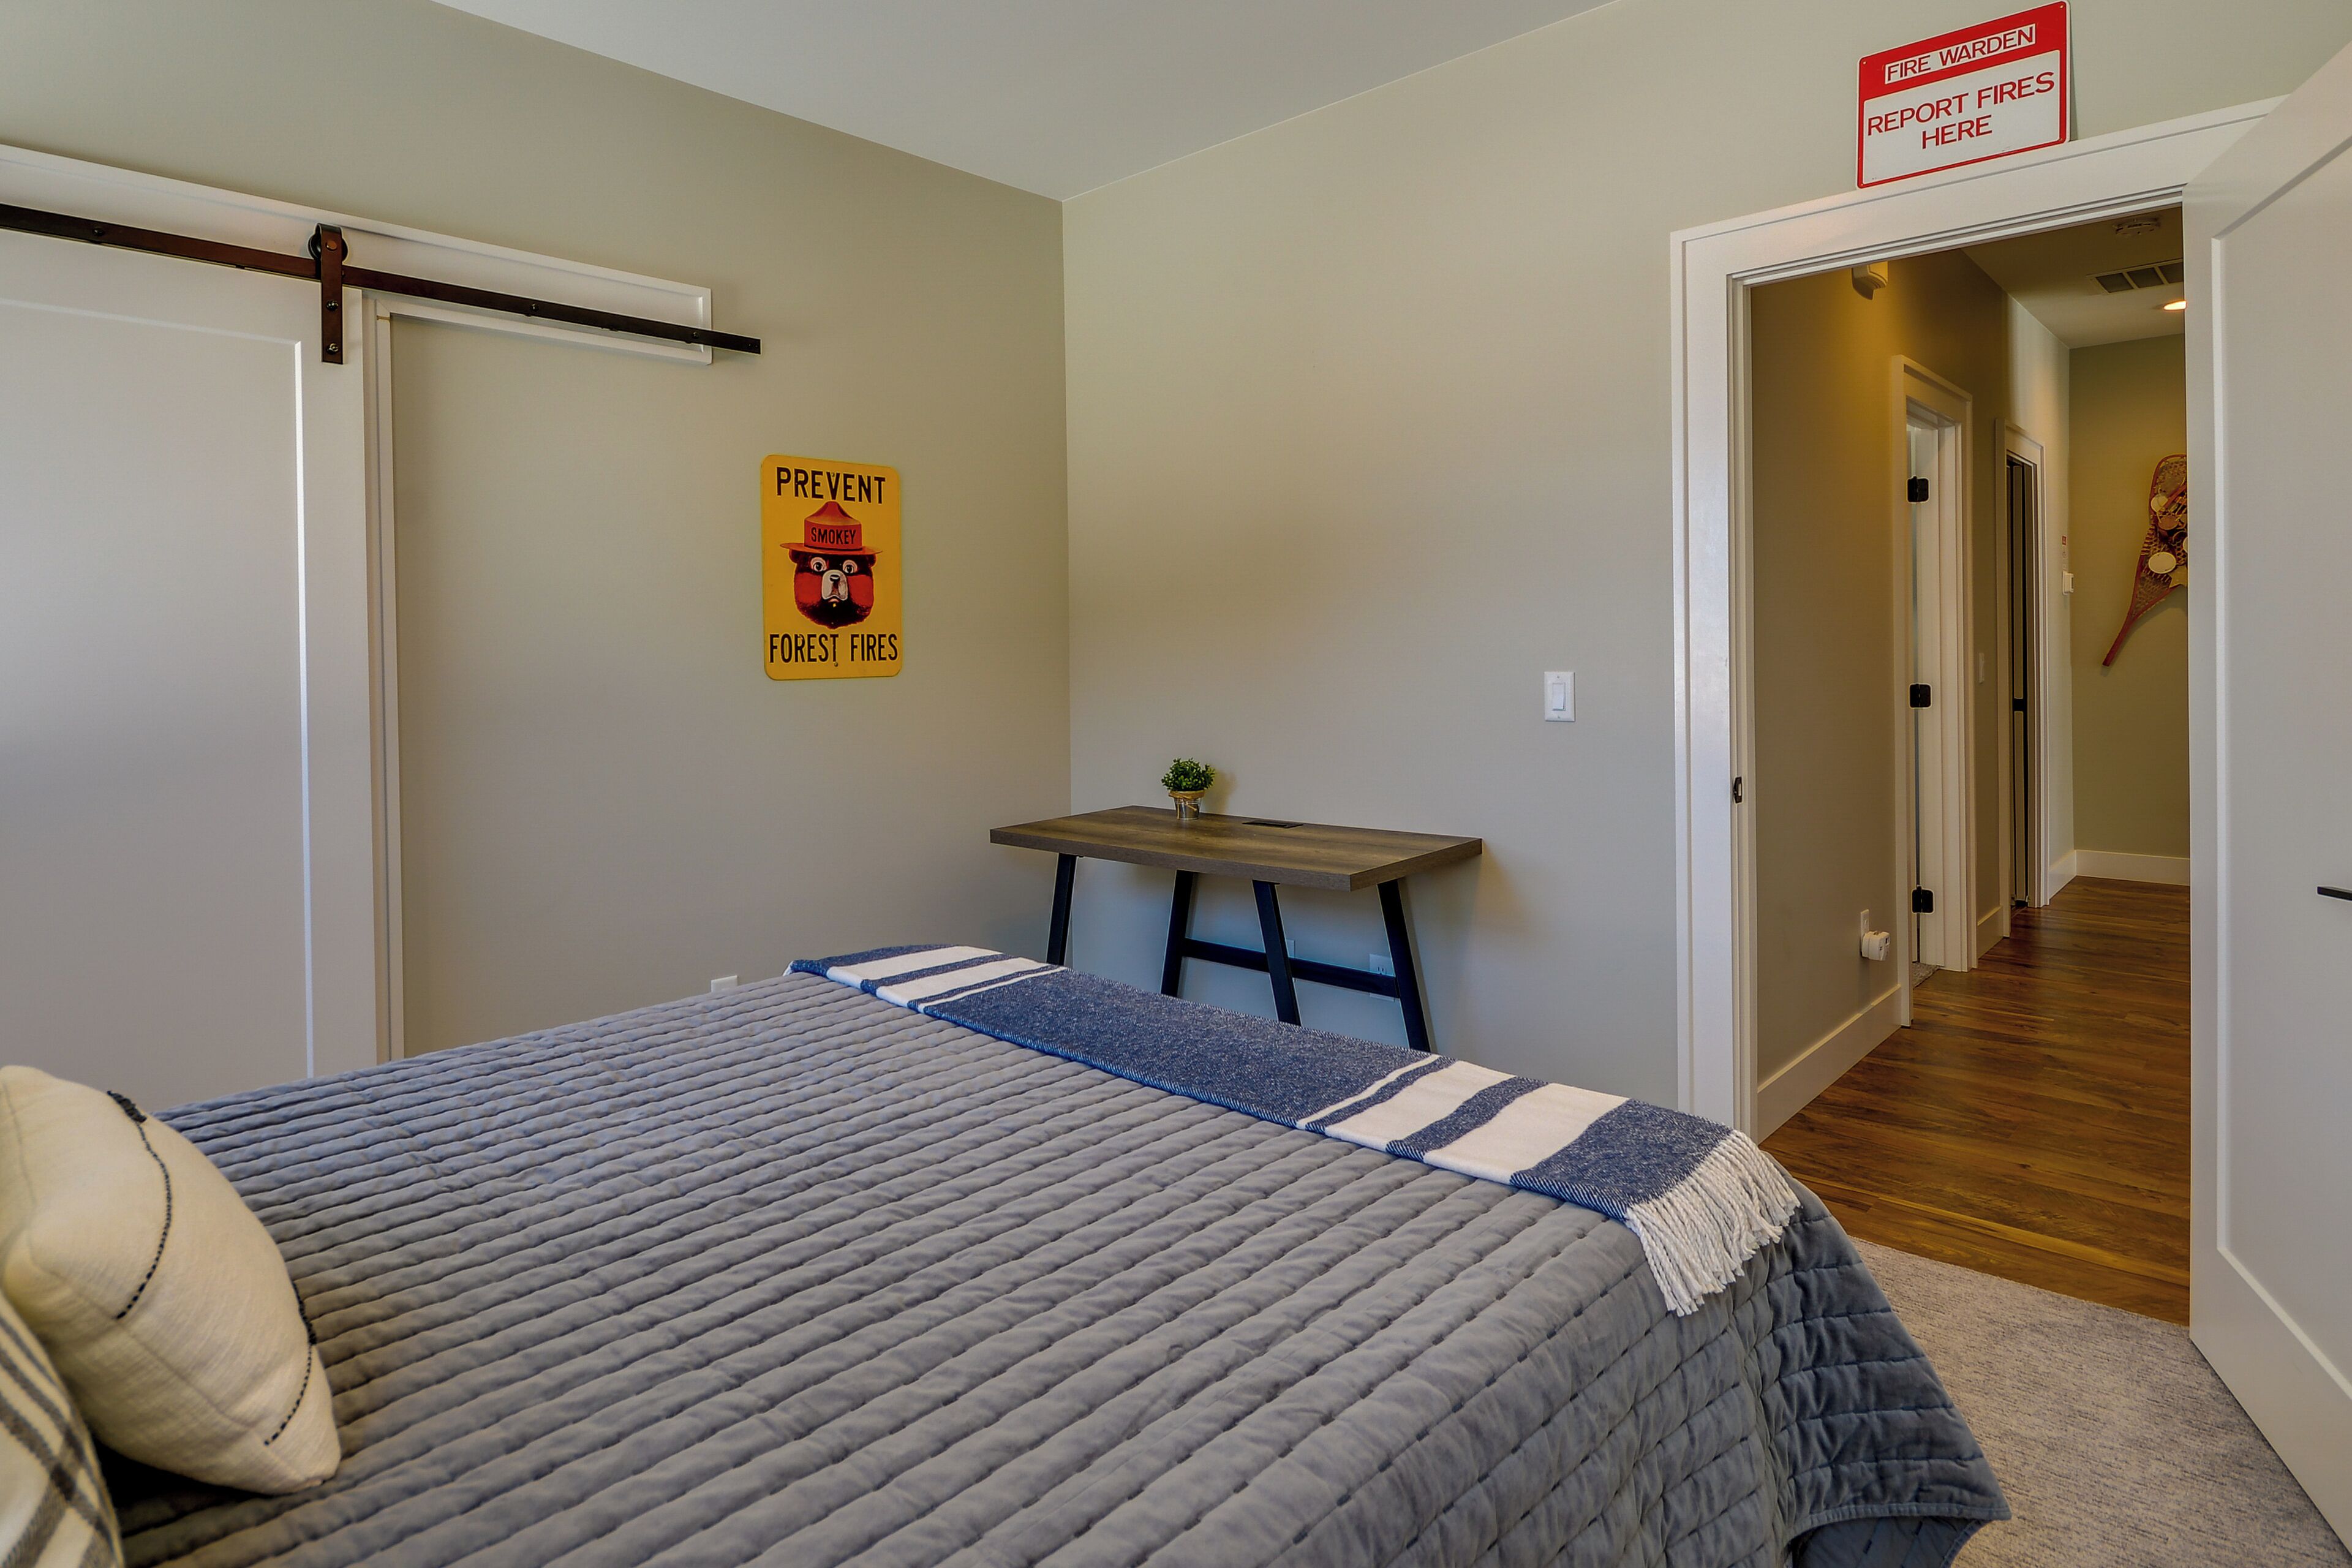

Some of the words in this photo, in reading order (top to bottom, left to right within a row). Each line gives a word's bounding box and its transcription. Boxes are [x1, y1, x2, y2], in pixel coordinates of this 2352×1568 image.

[1887, 55, 1931, 81] FIRE
[1939, 26, 2034, 67] WARDEN
[1868, 93, 1969, 136] REPORT
[1977, 72, 2054, 108] FIRES
[1922, 115, 1992, 149] HERE
[776, 466, 886, 504] PREVENT
[811, 526, 856, 545] SMOKEY
[769, 633, 839, 663] FOREST
[850, 633, 898, 662] FIRES
